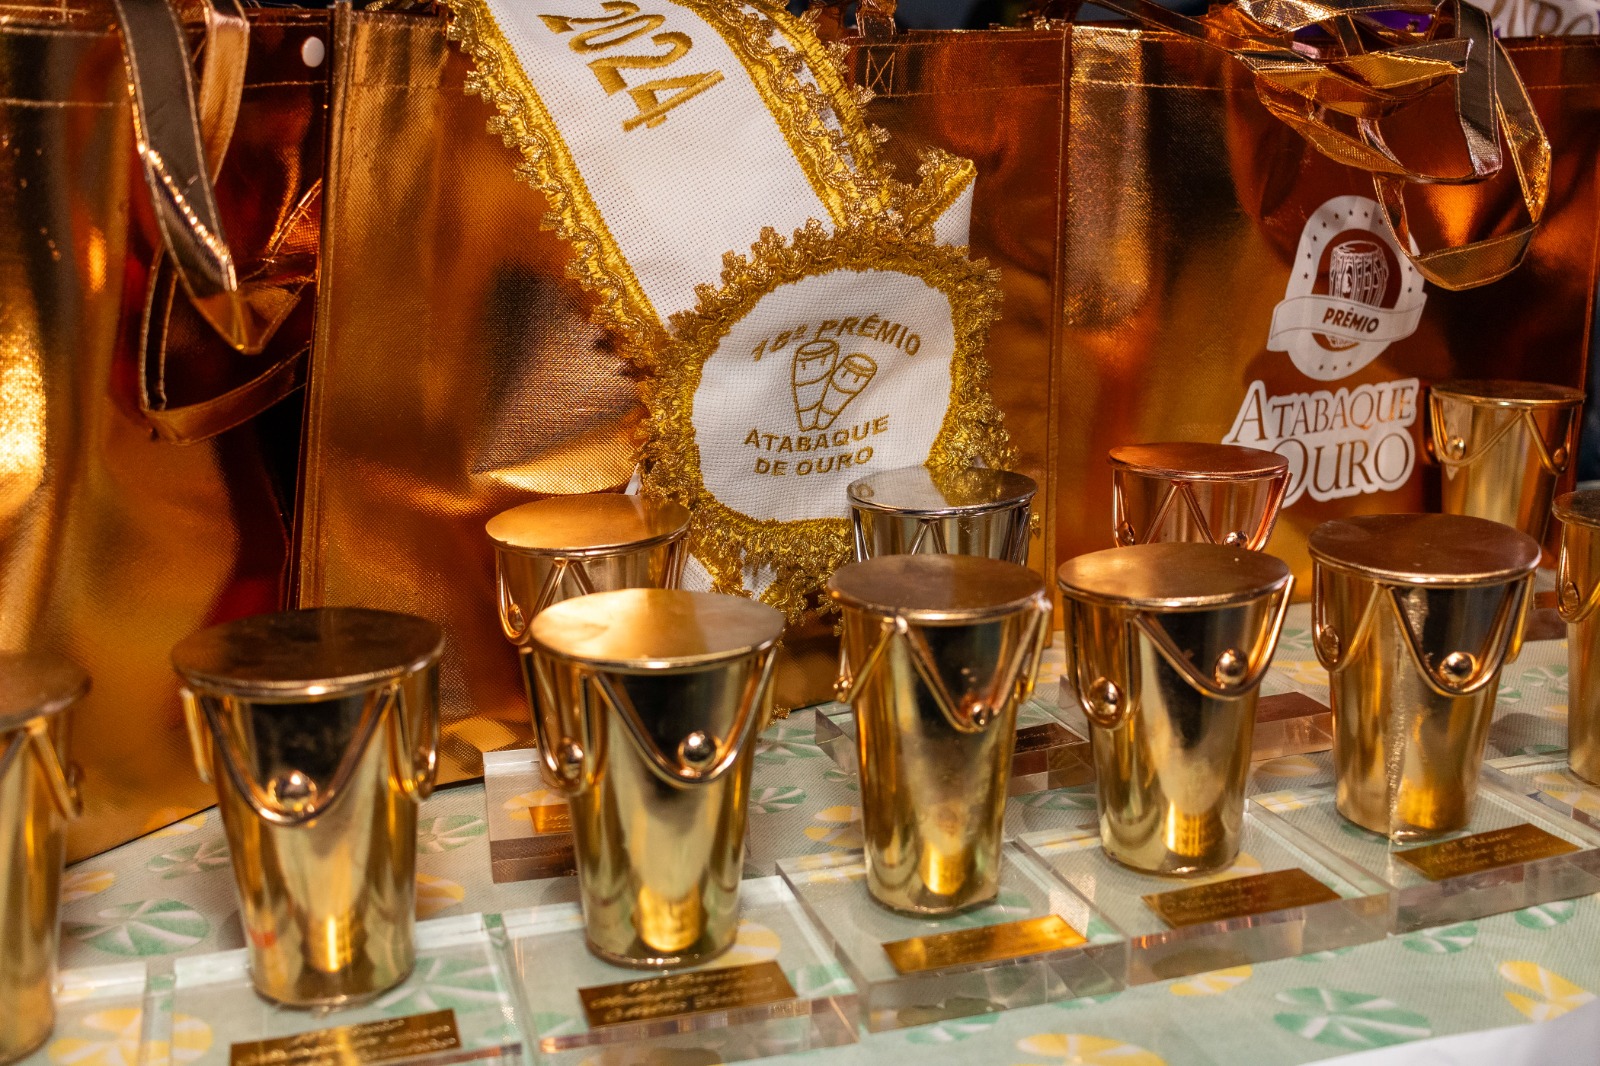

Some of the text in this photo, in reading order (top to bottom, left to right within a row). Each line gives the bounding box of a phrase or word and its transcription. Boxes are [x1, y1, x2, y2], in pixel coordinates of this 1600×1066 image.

[537, 1, 725, 132] 2024
[1322, 306, 1379, 334] PRÊMIO
[744, 414, 890, 453] ATABAQUE
[1230, 385, 1414, 443] ATABAQUE
[754, 446, 874, 477] DE OURO
